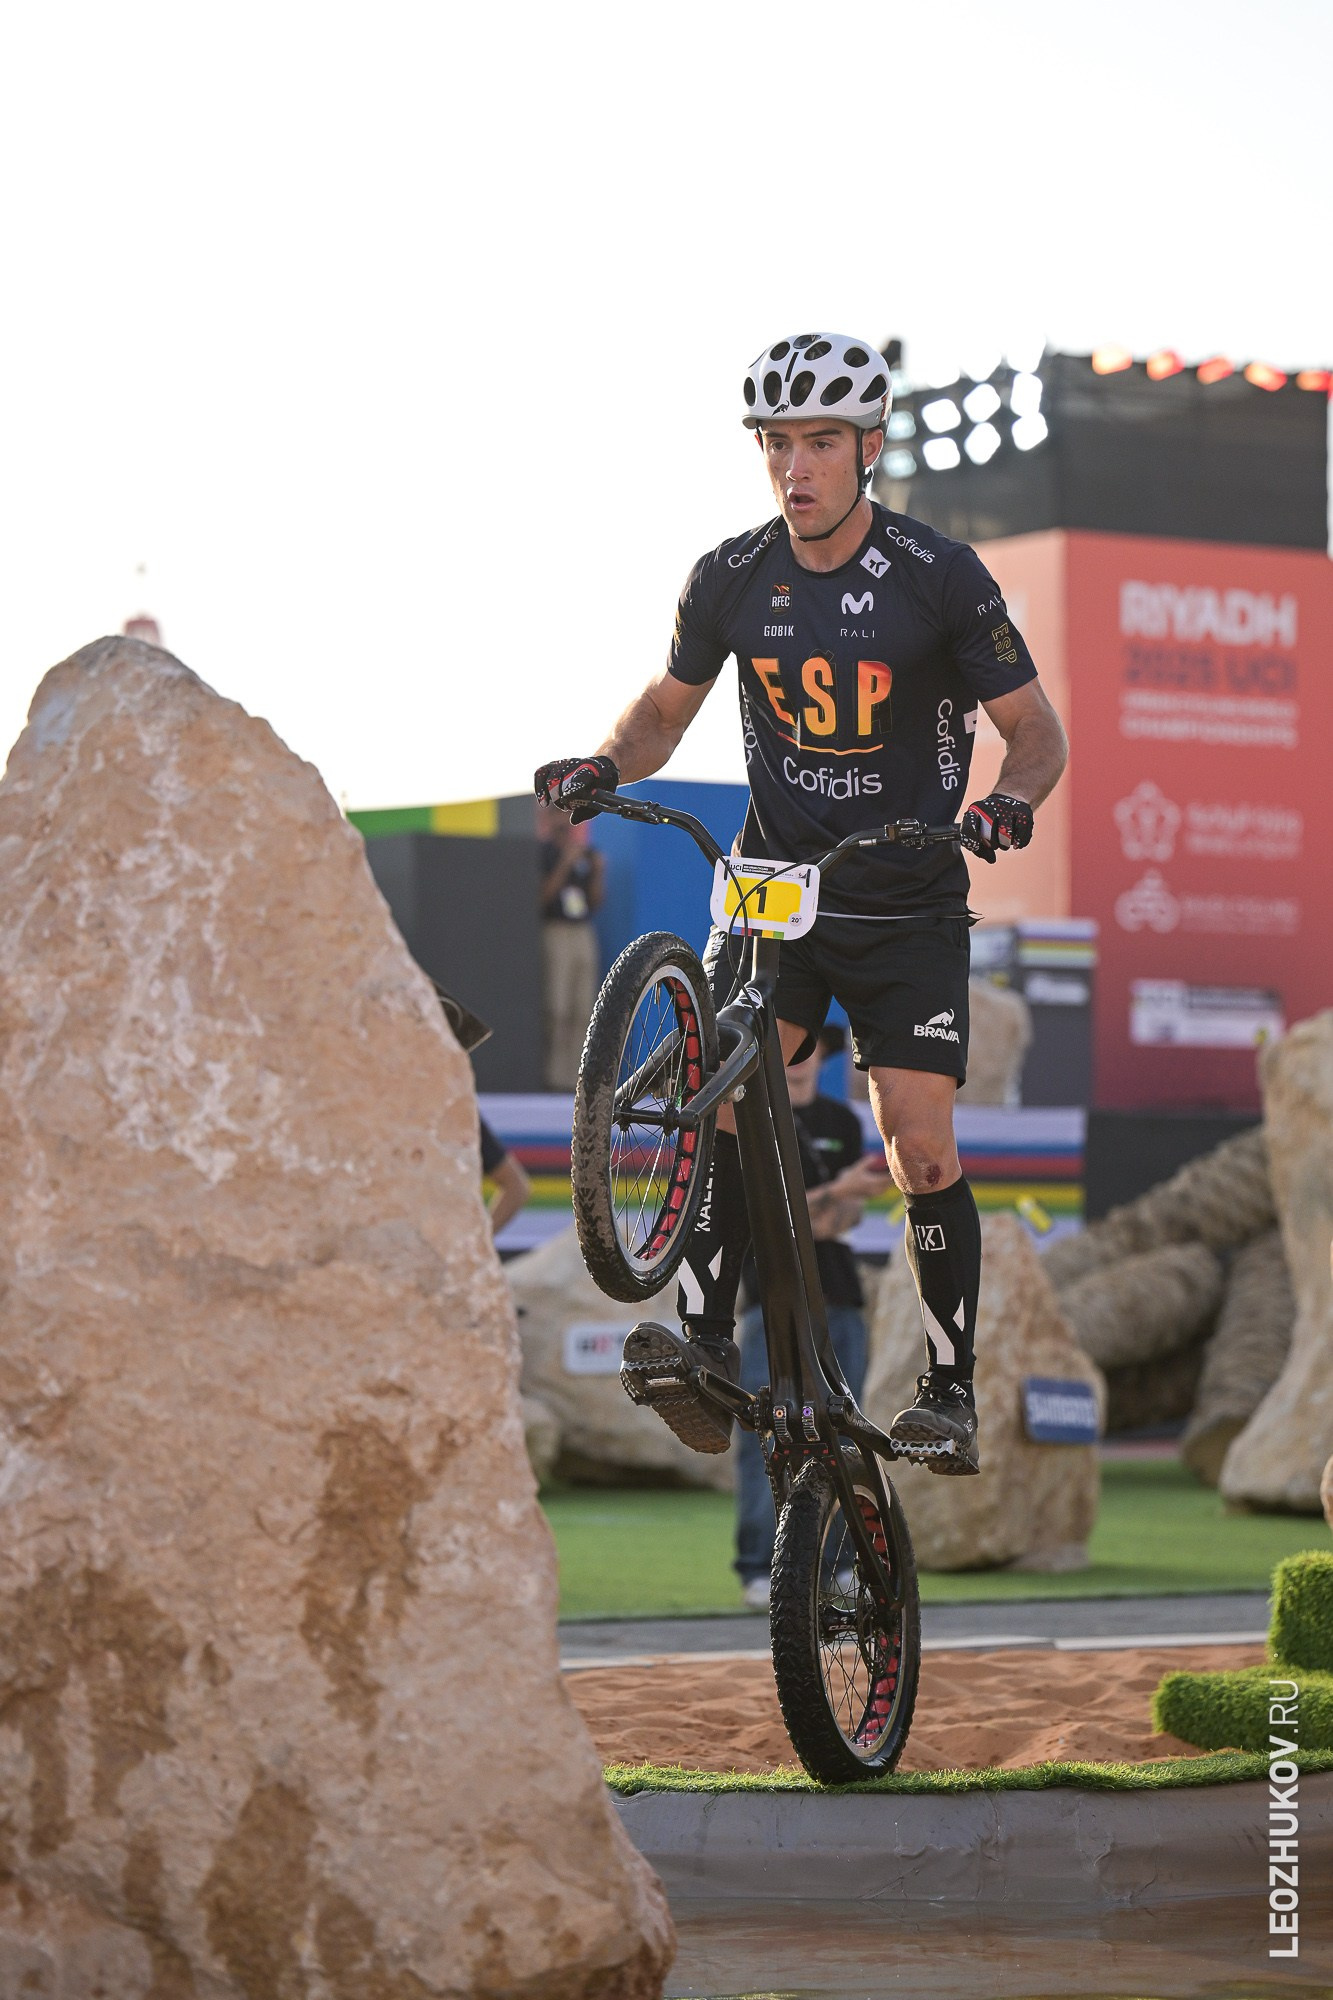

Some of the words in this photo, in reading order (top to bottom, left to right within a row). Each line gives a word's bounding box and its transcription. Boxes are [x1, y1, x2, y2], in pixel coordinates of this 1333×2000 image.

[886, 526, 935, 564] Cofidis
[772, 595, 790, 607] RFEC
[1120, 582, 1297, 648] RIYADH
[764, 625, 794, 637] GOBIK
[840, 629, 875, 638] RALI
[991, 622, 1018, 663] ESP
[751, 657, 893, 736] ESP
[937, 698, 961, 791] Cofidis
[783, 756, 883, 800] Cofidis
[756, 886, 767, 914] 1
